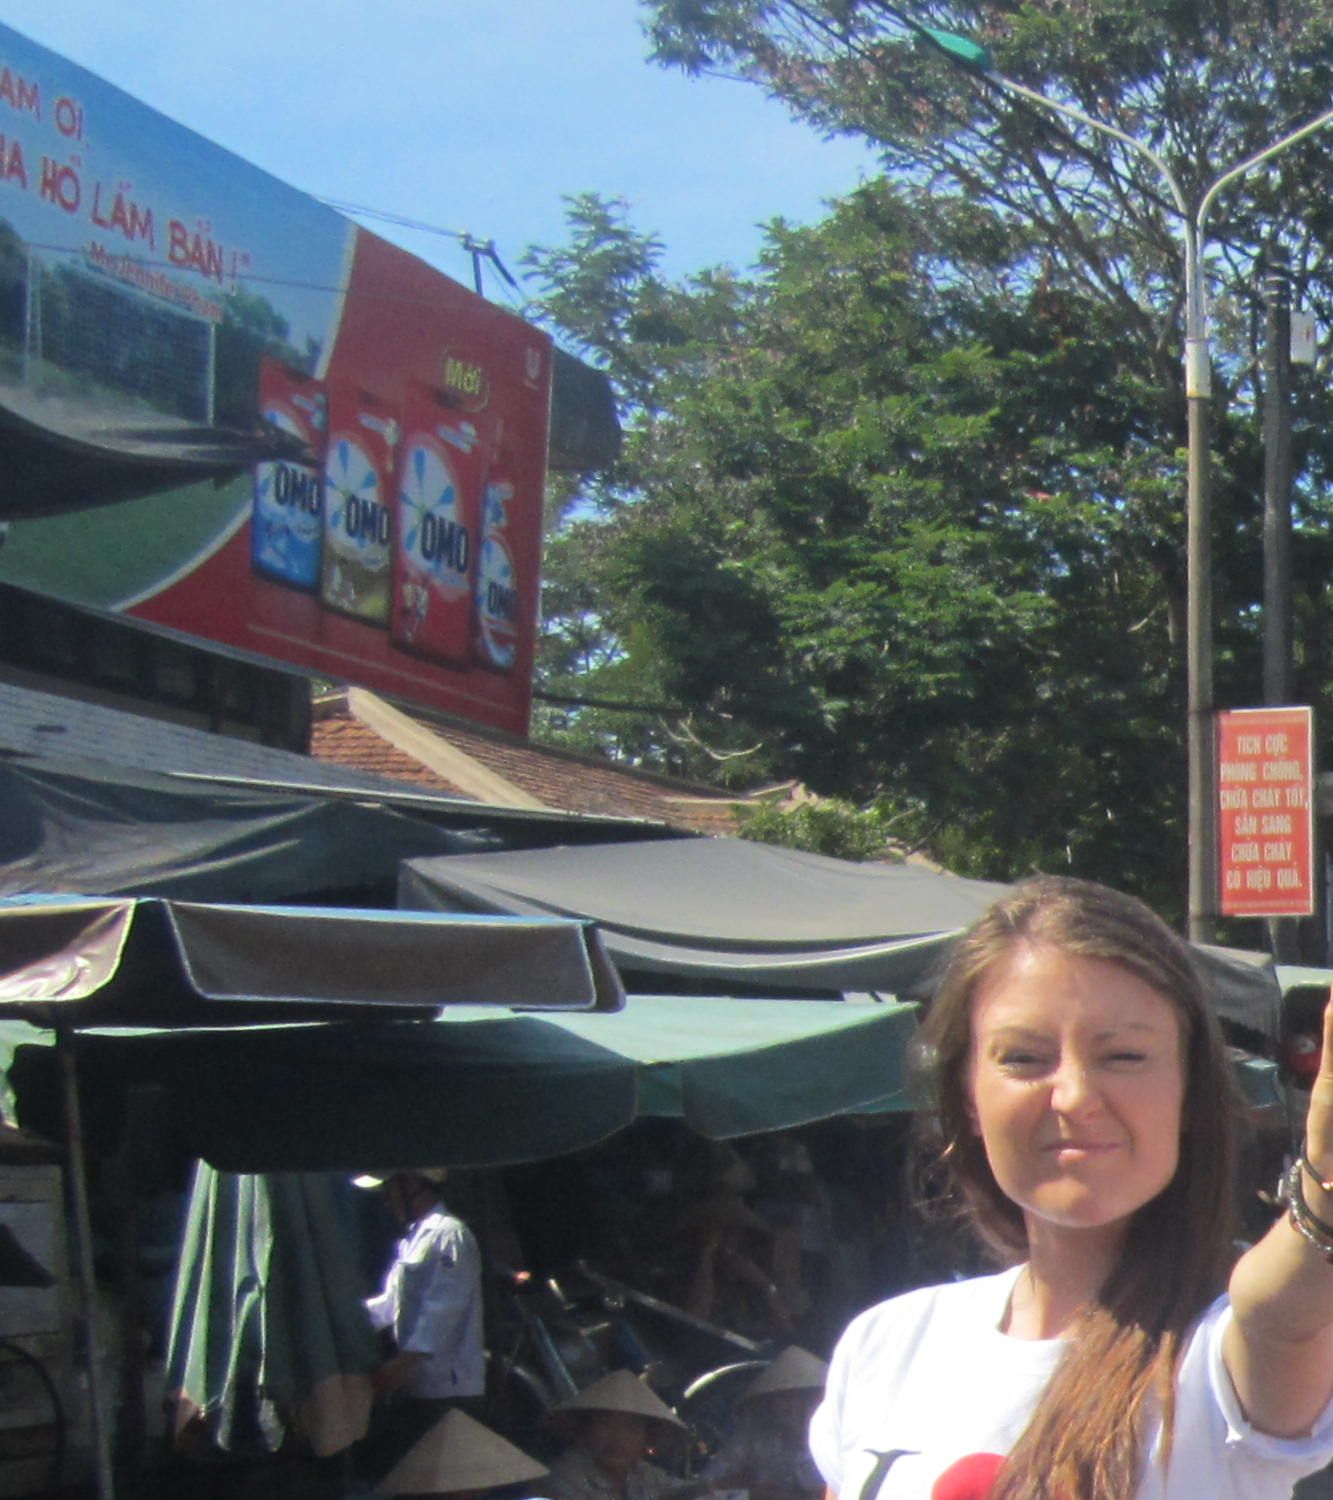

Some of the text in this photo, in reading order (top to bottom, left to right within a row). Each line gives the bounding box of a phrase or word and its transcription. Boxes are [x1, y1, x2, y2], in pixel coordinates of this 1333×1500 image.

[275, 463, 320, 516] OMO
[346, 494, 391, 548] OMO
[421, 511, 469, 574] OMO
